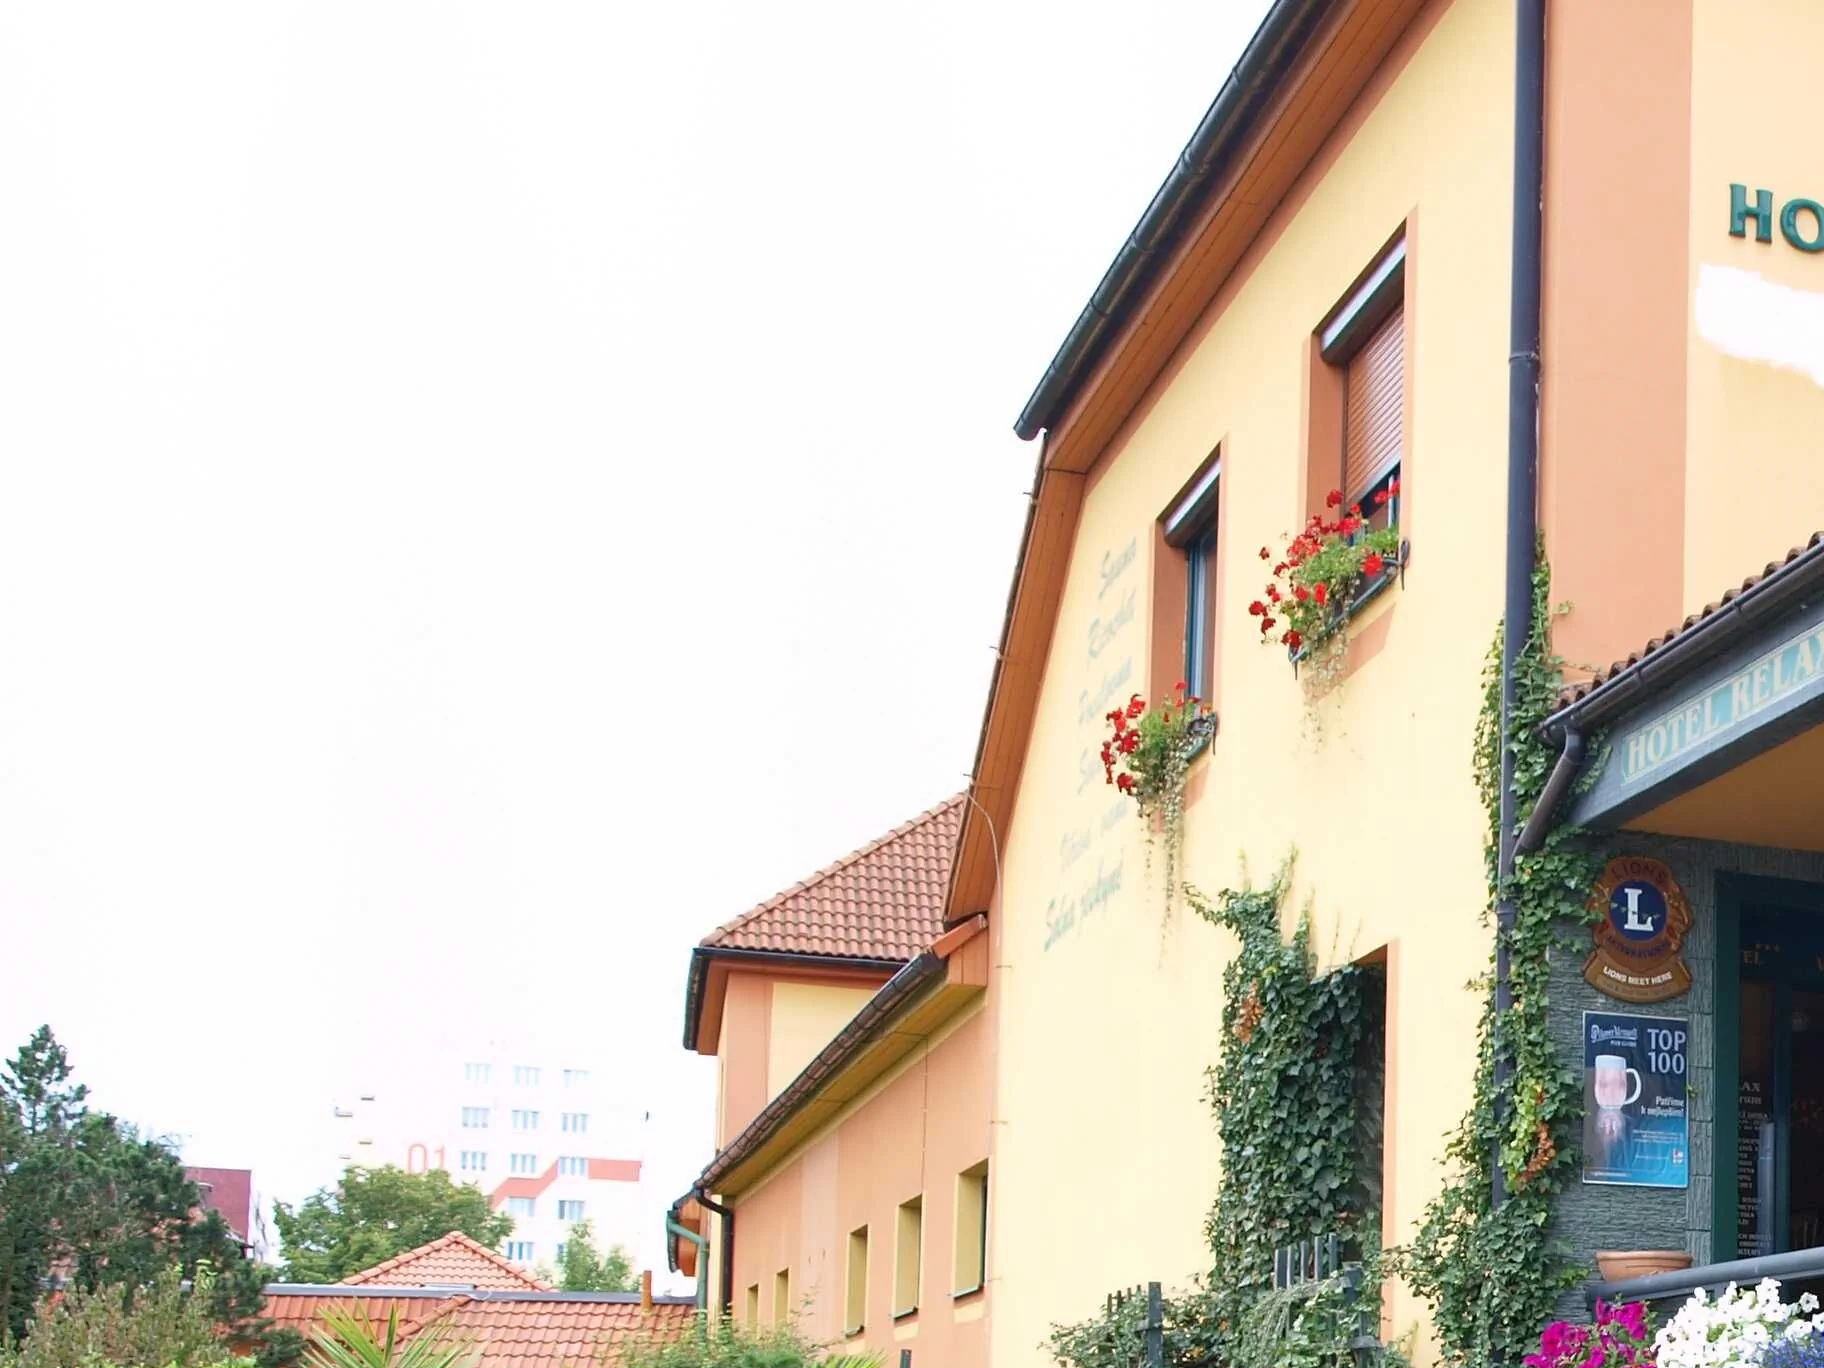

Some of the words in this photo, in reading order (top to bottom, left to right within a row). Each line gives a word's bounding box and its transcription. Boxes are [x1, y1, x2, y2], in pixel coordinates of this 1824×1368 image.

[1626, 695, 1721, 778] HOTEL
[1611, 861, 1670, 884] LIONS
[1624, 887, 1654, 932] L
[1647, 1028, 1686, 1052] TOP
[1647, 1052, 1685, 1075] 100
